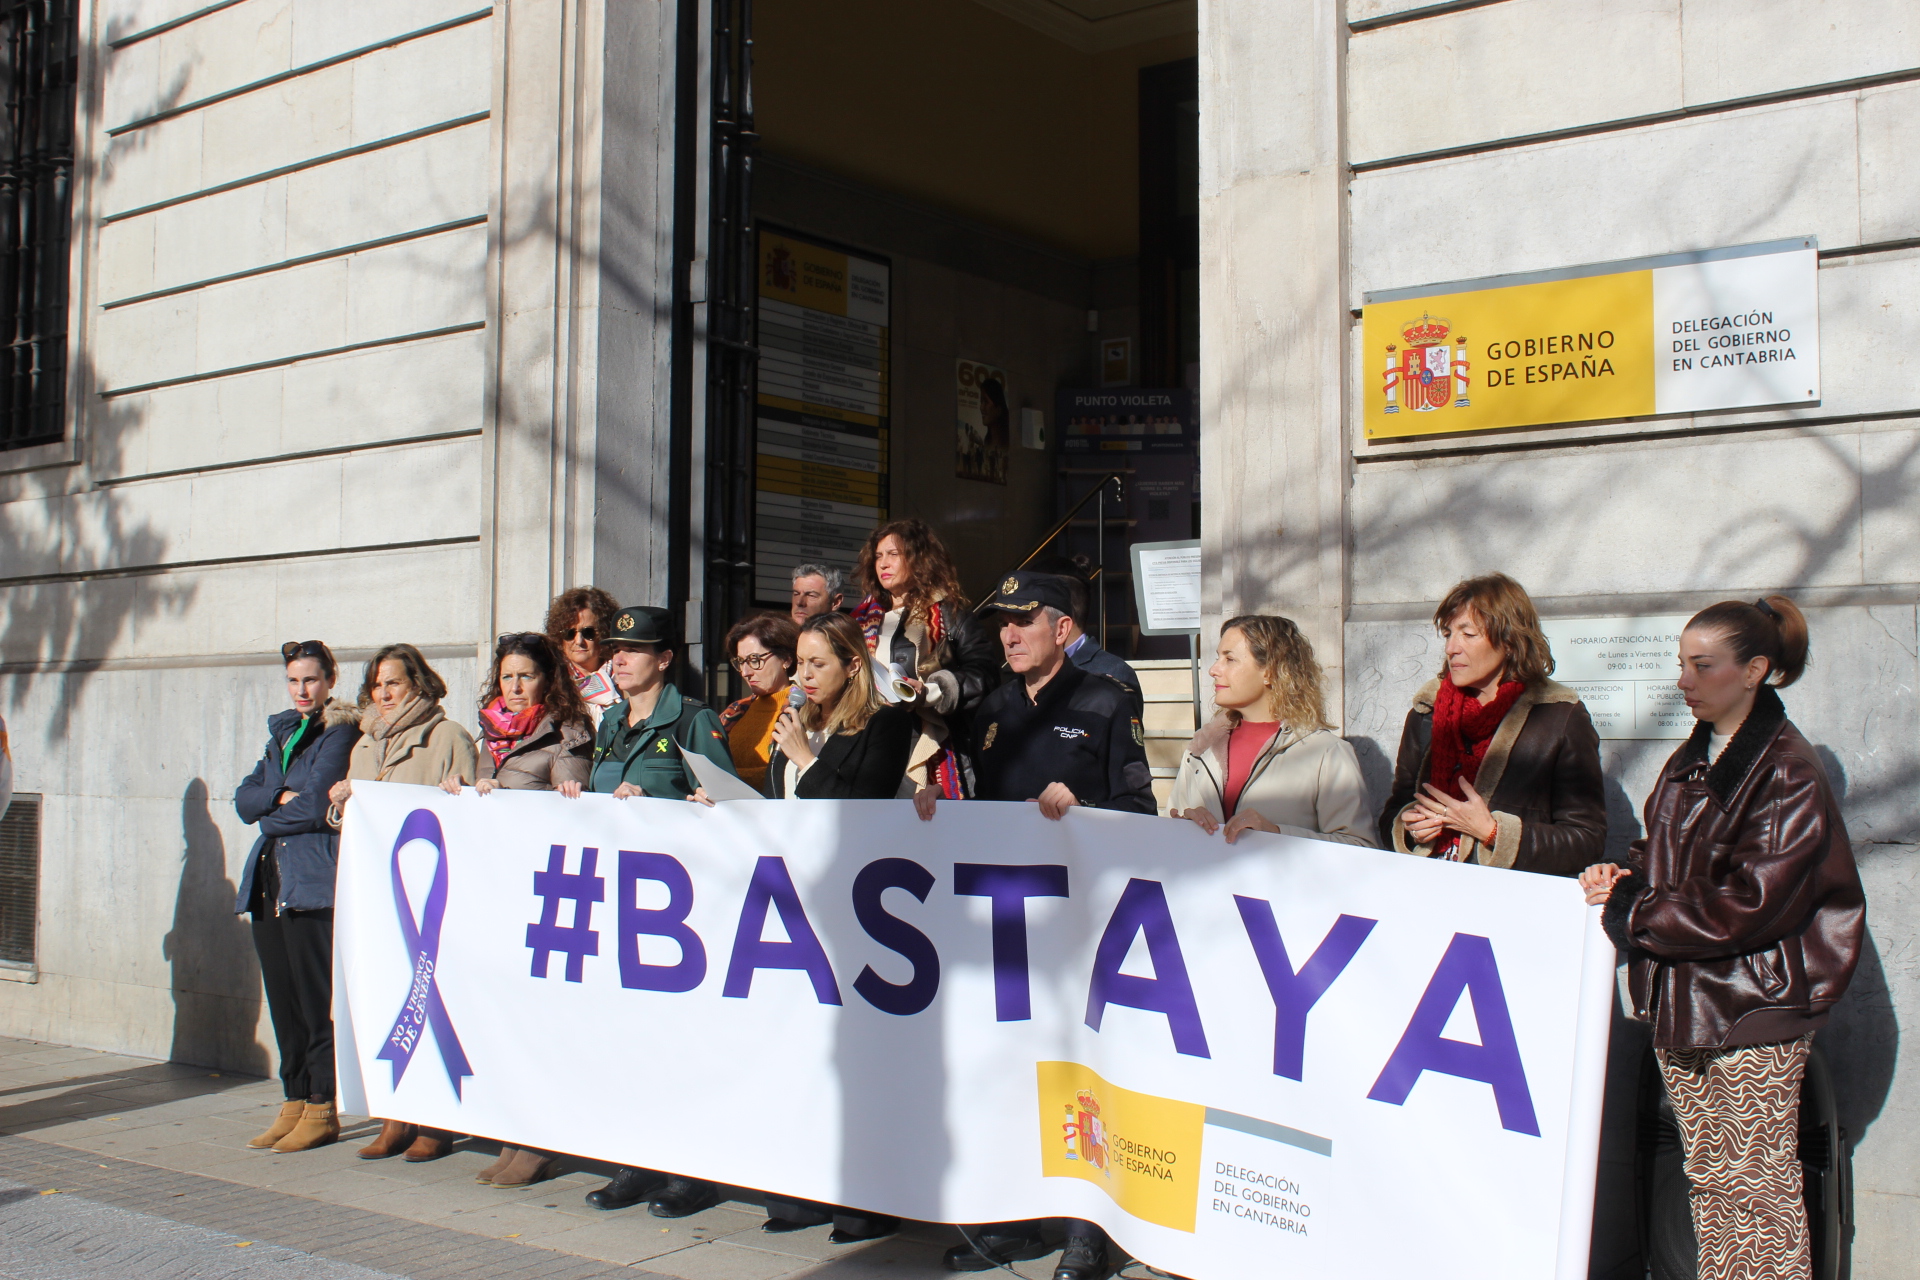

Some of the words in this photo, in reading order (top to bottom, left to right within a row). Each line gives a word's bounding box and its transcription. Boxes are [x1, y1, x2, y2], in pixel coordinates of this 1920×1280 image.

[803, 262, 843, 281] GOBIERNO
[803, 275, 814, 287] DE
[816, 279, 842, 293] ESPAÑA
[1672, 310, 1773, 334] DELEGACIÓN
[1486, 329, 1615, 361] GOBIERNO
[1672, 336, 1700, 353] DEL
[1708, 328, 1791, 349] GOBIERNO
[1487, 368, 1515, 388] DE
[1525, 355, 1615, 384] ESPAÑA
[1672, 355, 1693, 372] EN
[1699, 348, 1796, 369] CANTABRIA
[1075, 396, 1117, 406] PUNTO
[1120, 396, 1171, 406] VIOLETA
[1609, 634, 1653, 643] ATENCIÓN
[1635, 650, 1661, 658] Viernes
[1636, 662, 1653, 670] 14:00
[406, 950, 427, 1012] VIOLENCIA
[525, 844, 1541, 1138] #BASTAYA
[400, 1025, 417, 1054] DE
[413, 960, 434, 1024] GENERO
[403, 1015, 410, 1023] +
[391, 1024, 404, 1047] NO
[1112, 1134, 1176, 1165] GOBIERNO
[1113, 1149, 1124, 1166] DE
[1127, 1157, 1174, 1182] ESPAÑA
[1215, 1161, 1300, 1195] DELEGACIÓN
[1214, 1180, 1238, 1198] DEL
[1242, 1187, 1311, 1218] GOBIERNO
[1213, 1198, 1230, 1214] EN
[1234, 1203, 1308, 1237] CANTABRIA
